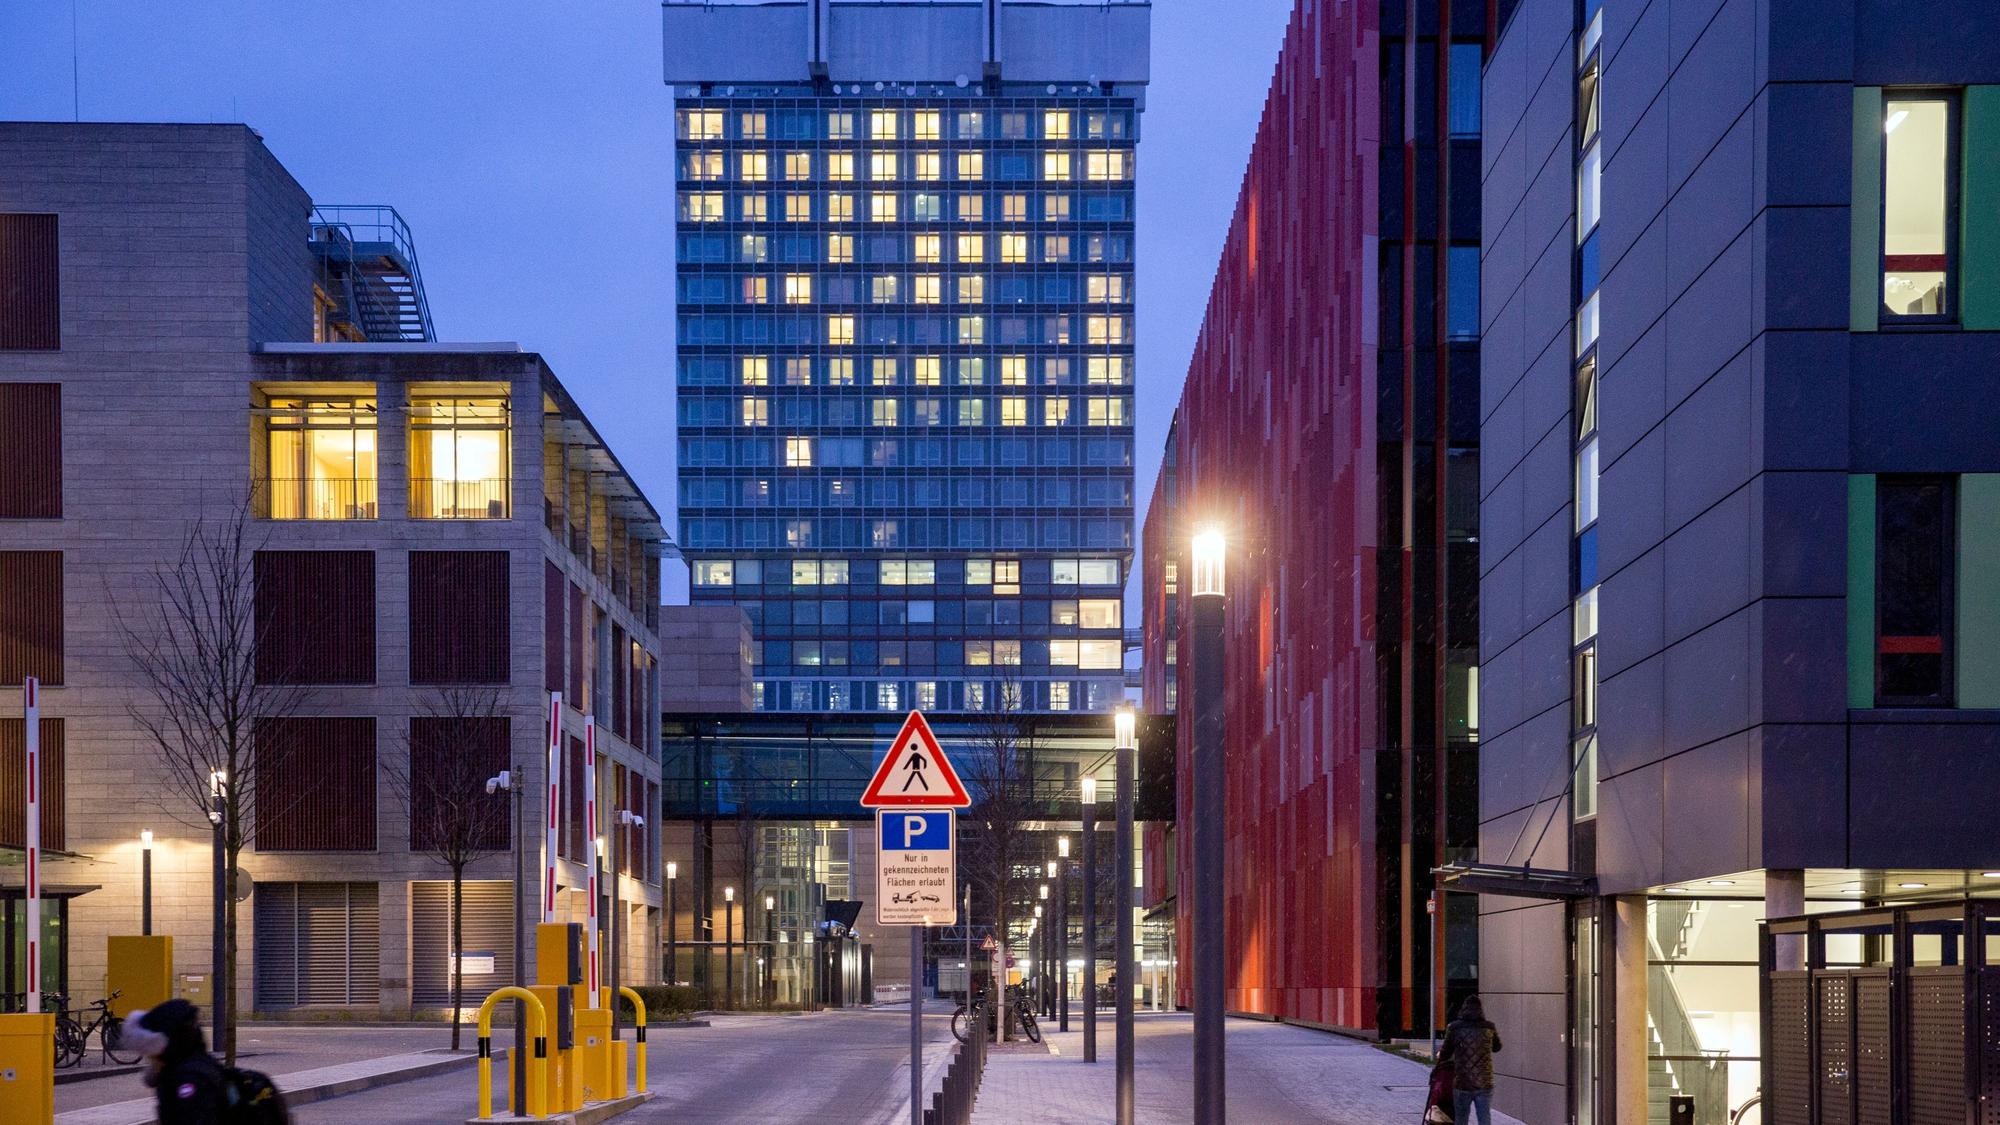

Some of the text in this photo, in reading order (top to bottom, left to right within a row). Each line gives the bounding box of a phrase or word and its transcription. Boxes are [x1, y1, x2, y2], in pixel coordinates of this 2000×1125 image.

[904, 815, 927, 847] P
[904, 854, 928, 862] Nur in
[883, 866, 949, 876] gekennzeichneten
[887, 878, 945, 886] Flächen erlaubt
